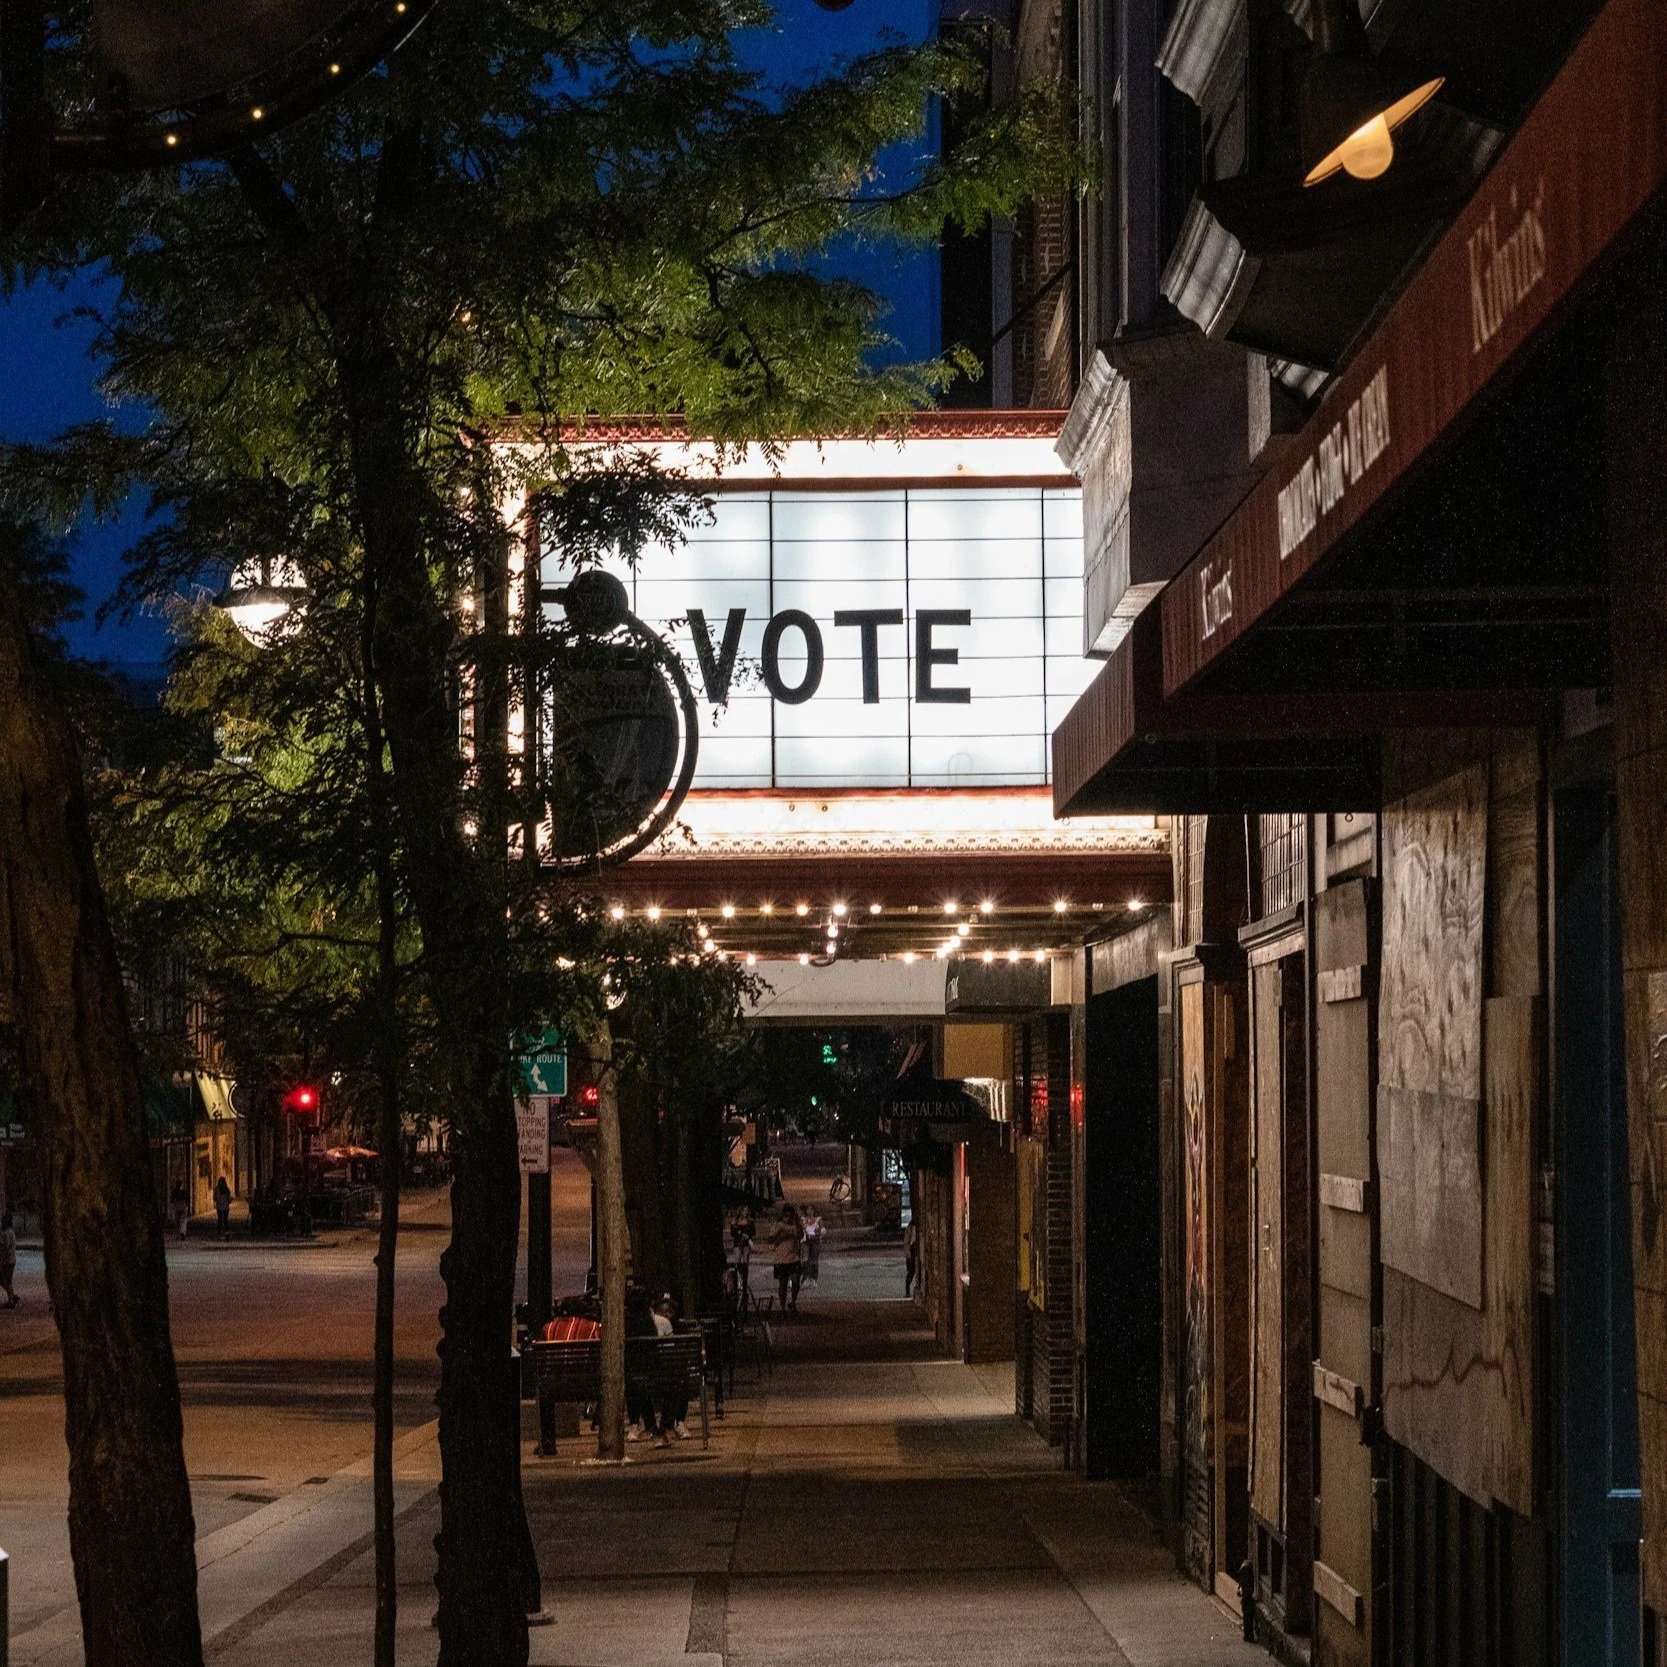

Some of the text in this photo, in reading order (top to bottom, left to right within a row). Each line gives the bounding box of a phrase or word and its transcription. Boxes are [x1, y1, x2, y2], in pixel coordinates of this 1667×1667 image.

[686, 608, 971, 704] VOTE
[536, 1054, 562, 1064] ROUTE
[892, 1101, 966, 1117] RESTAURANT
[518, 1117, 546, 1128] TOPPING
[520, 1144, 543, 1155] ARKING
